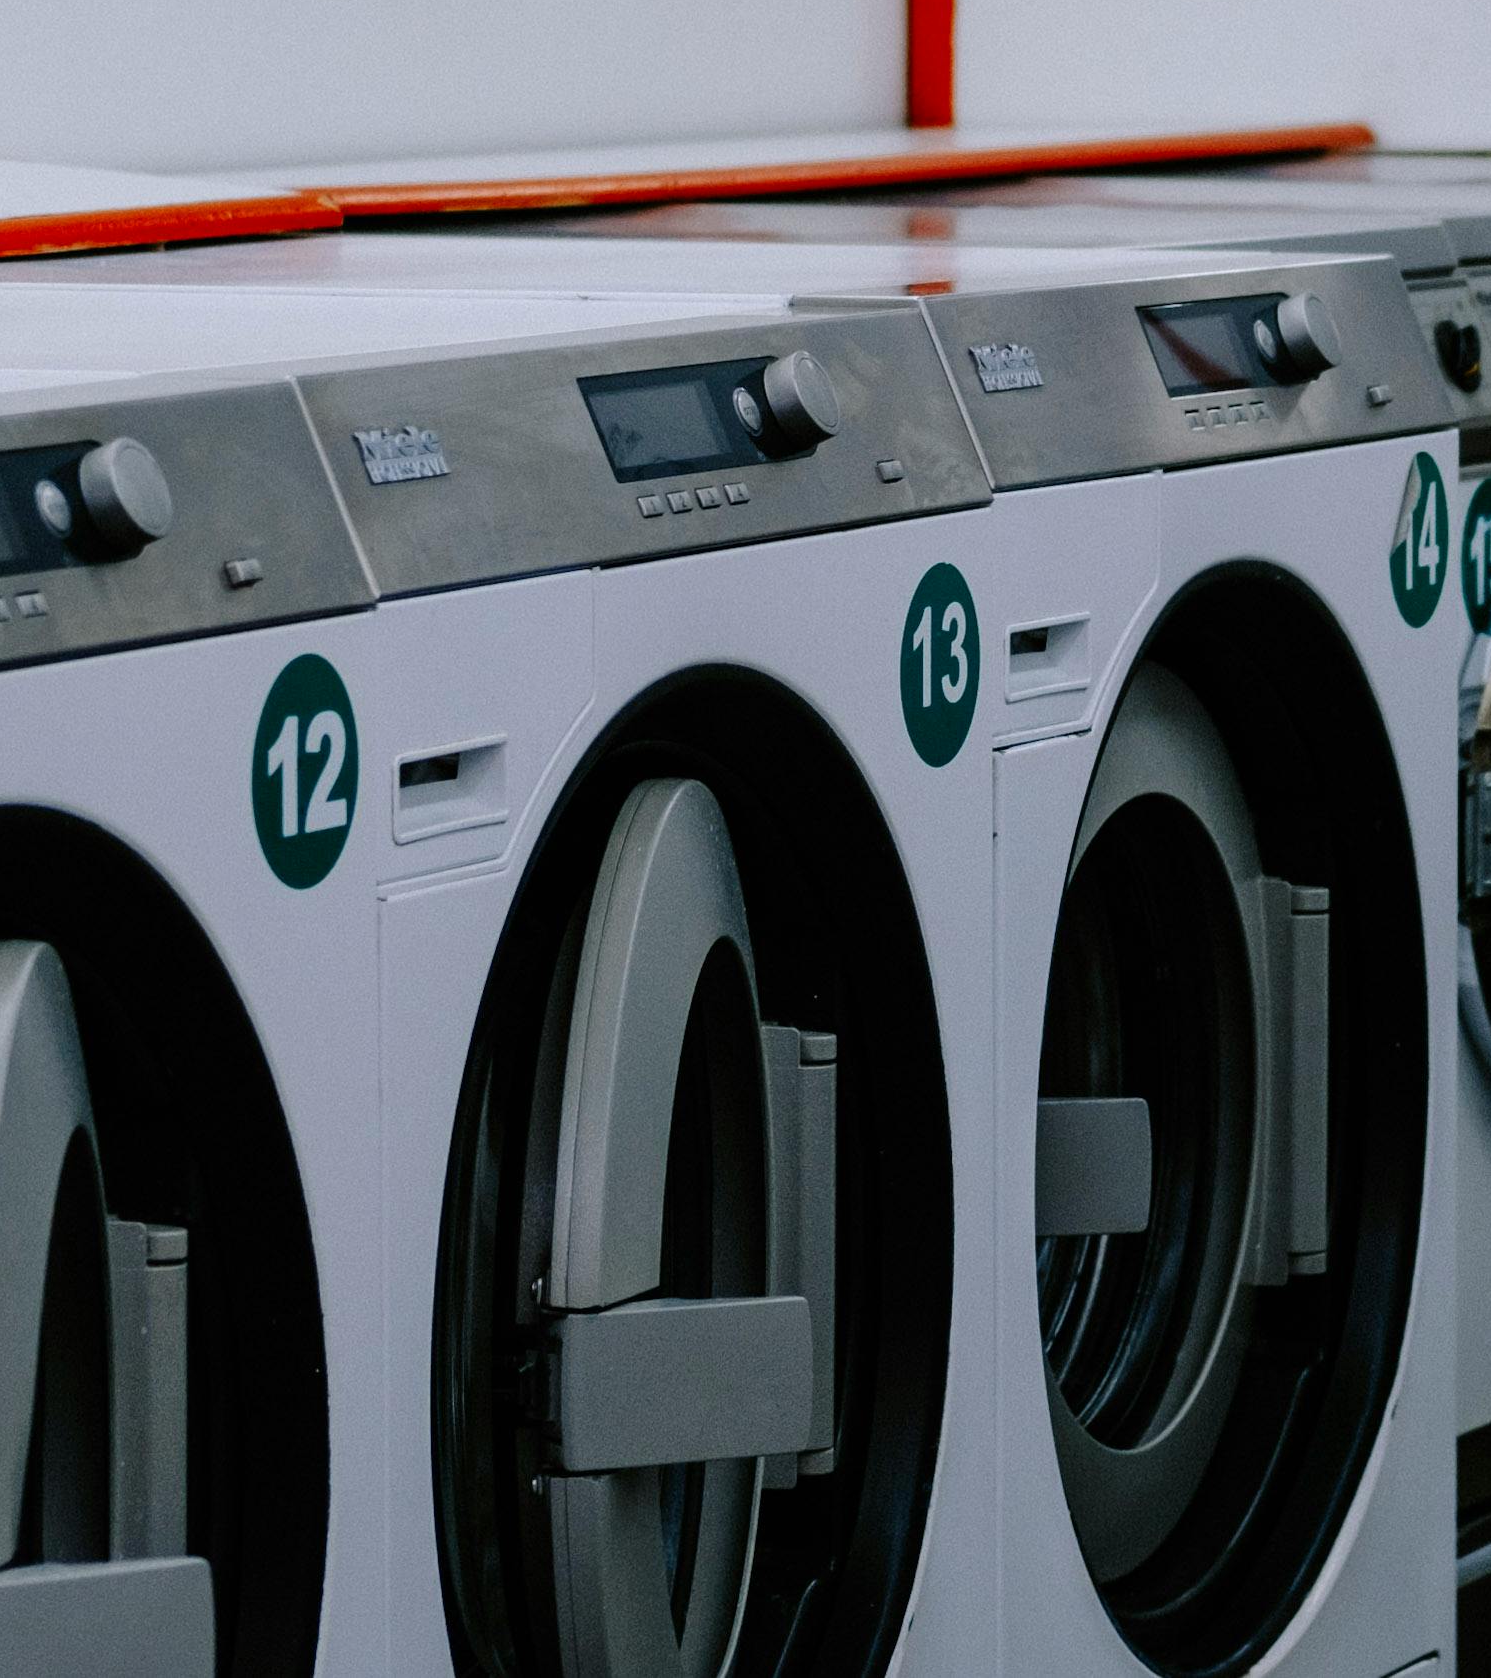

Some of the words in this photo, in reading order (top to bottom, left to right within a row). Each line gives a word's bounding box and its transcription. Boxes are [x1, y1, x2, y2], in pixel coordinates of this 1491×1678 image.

[1406, 481, 1440, 591] 14
[913, 601, 970, 709] 13
[266, 709, 348, 838] 12
